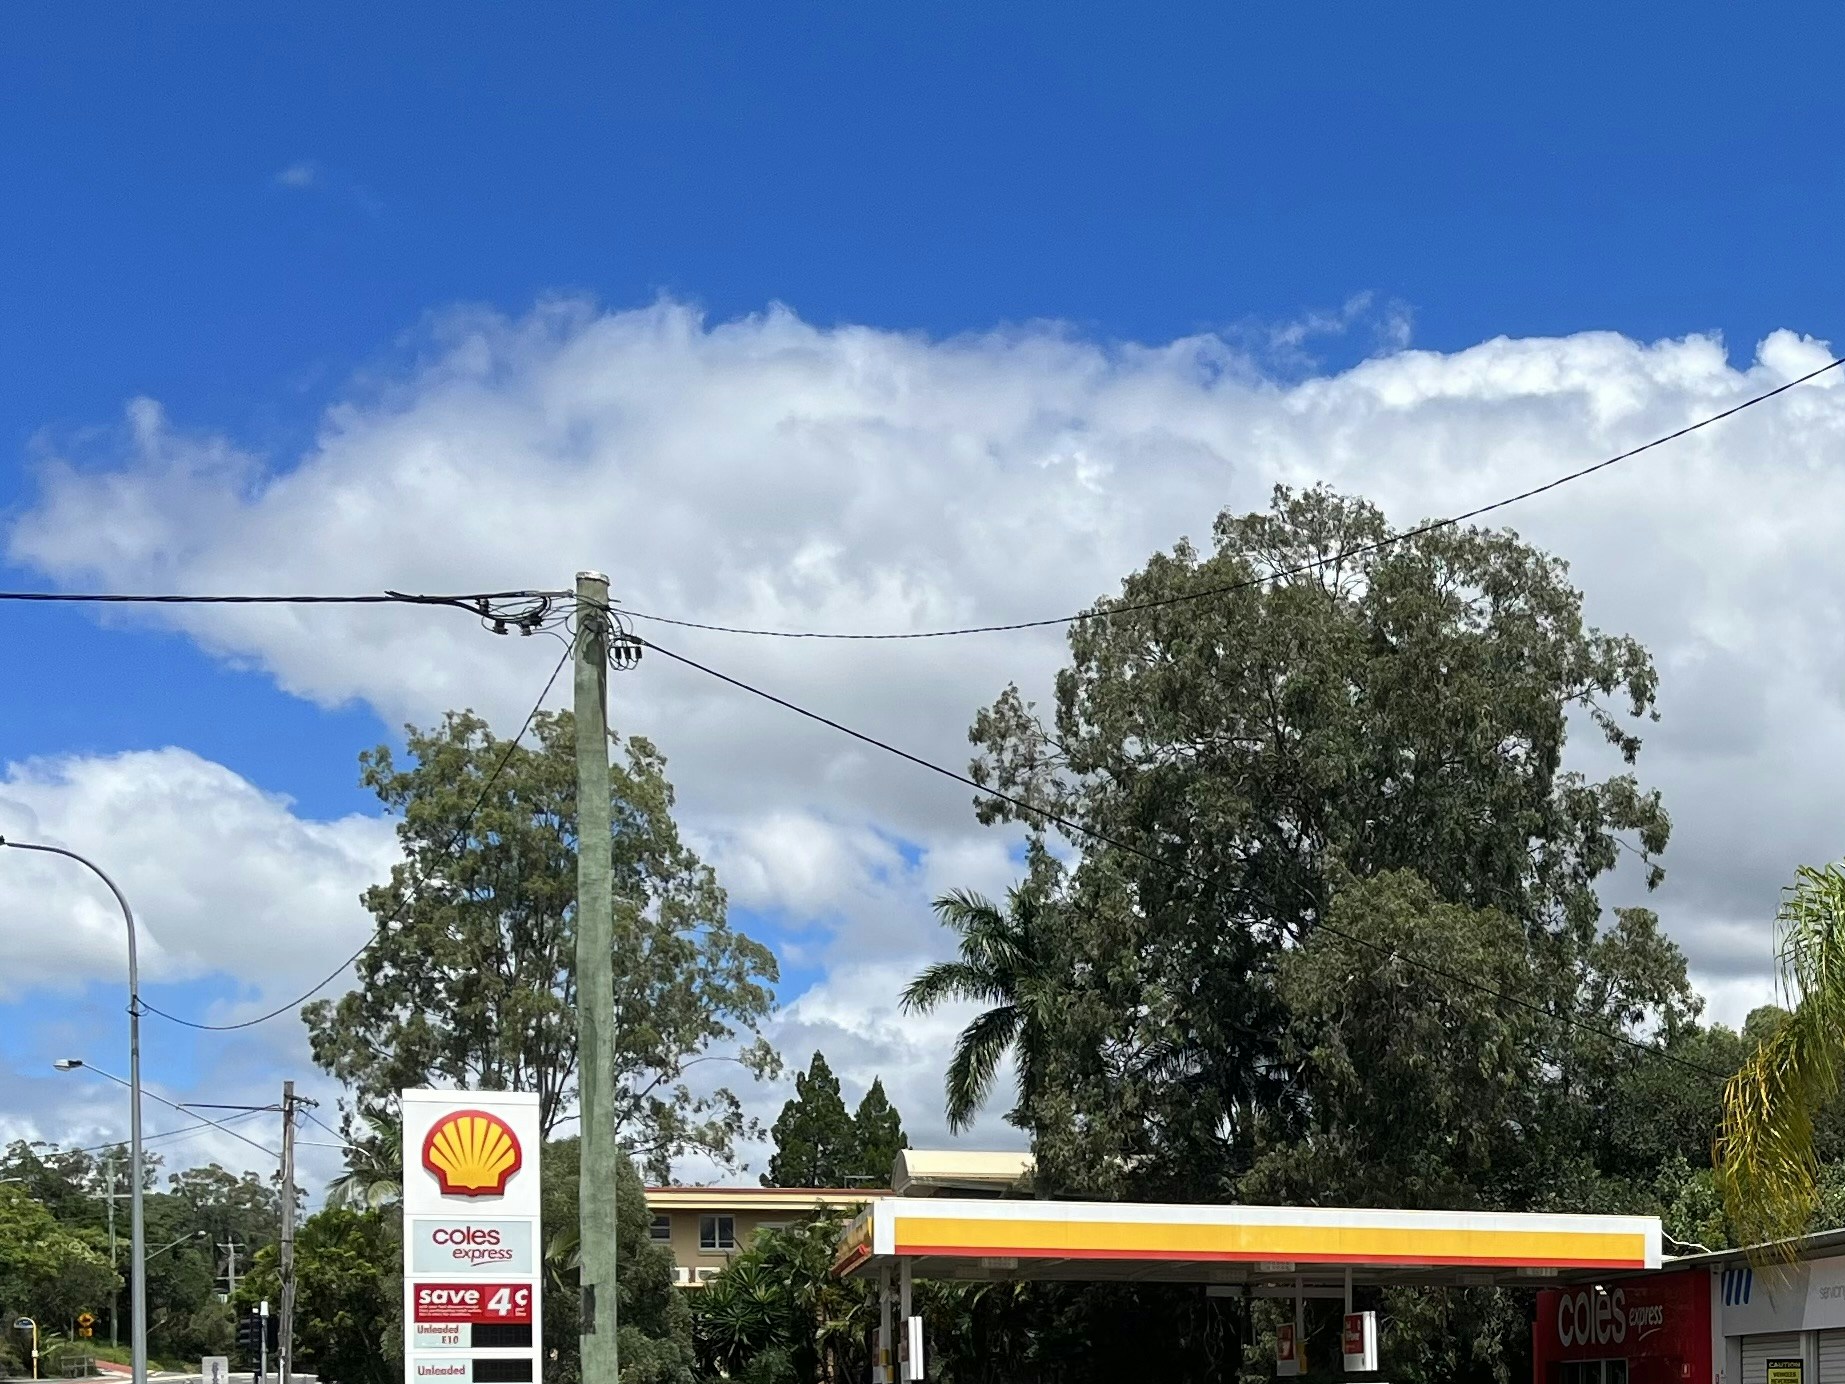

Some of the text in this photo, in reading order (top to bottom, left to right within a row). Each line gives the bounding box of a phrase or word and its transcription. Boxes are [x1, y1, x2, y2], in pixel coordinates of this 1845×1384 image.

[432, 1226, 501, 1245] coles
[452, 1247, 513, 1262] express
[418, 1289, 480, 1305] save
[1558, 1284, 1663, 1347] coles express
[417, 1324, 459, 1334] Unleaded
[441, 1336, 459, 1345] E10
[417, 1364, 466, 1376] Unleaded
